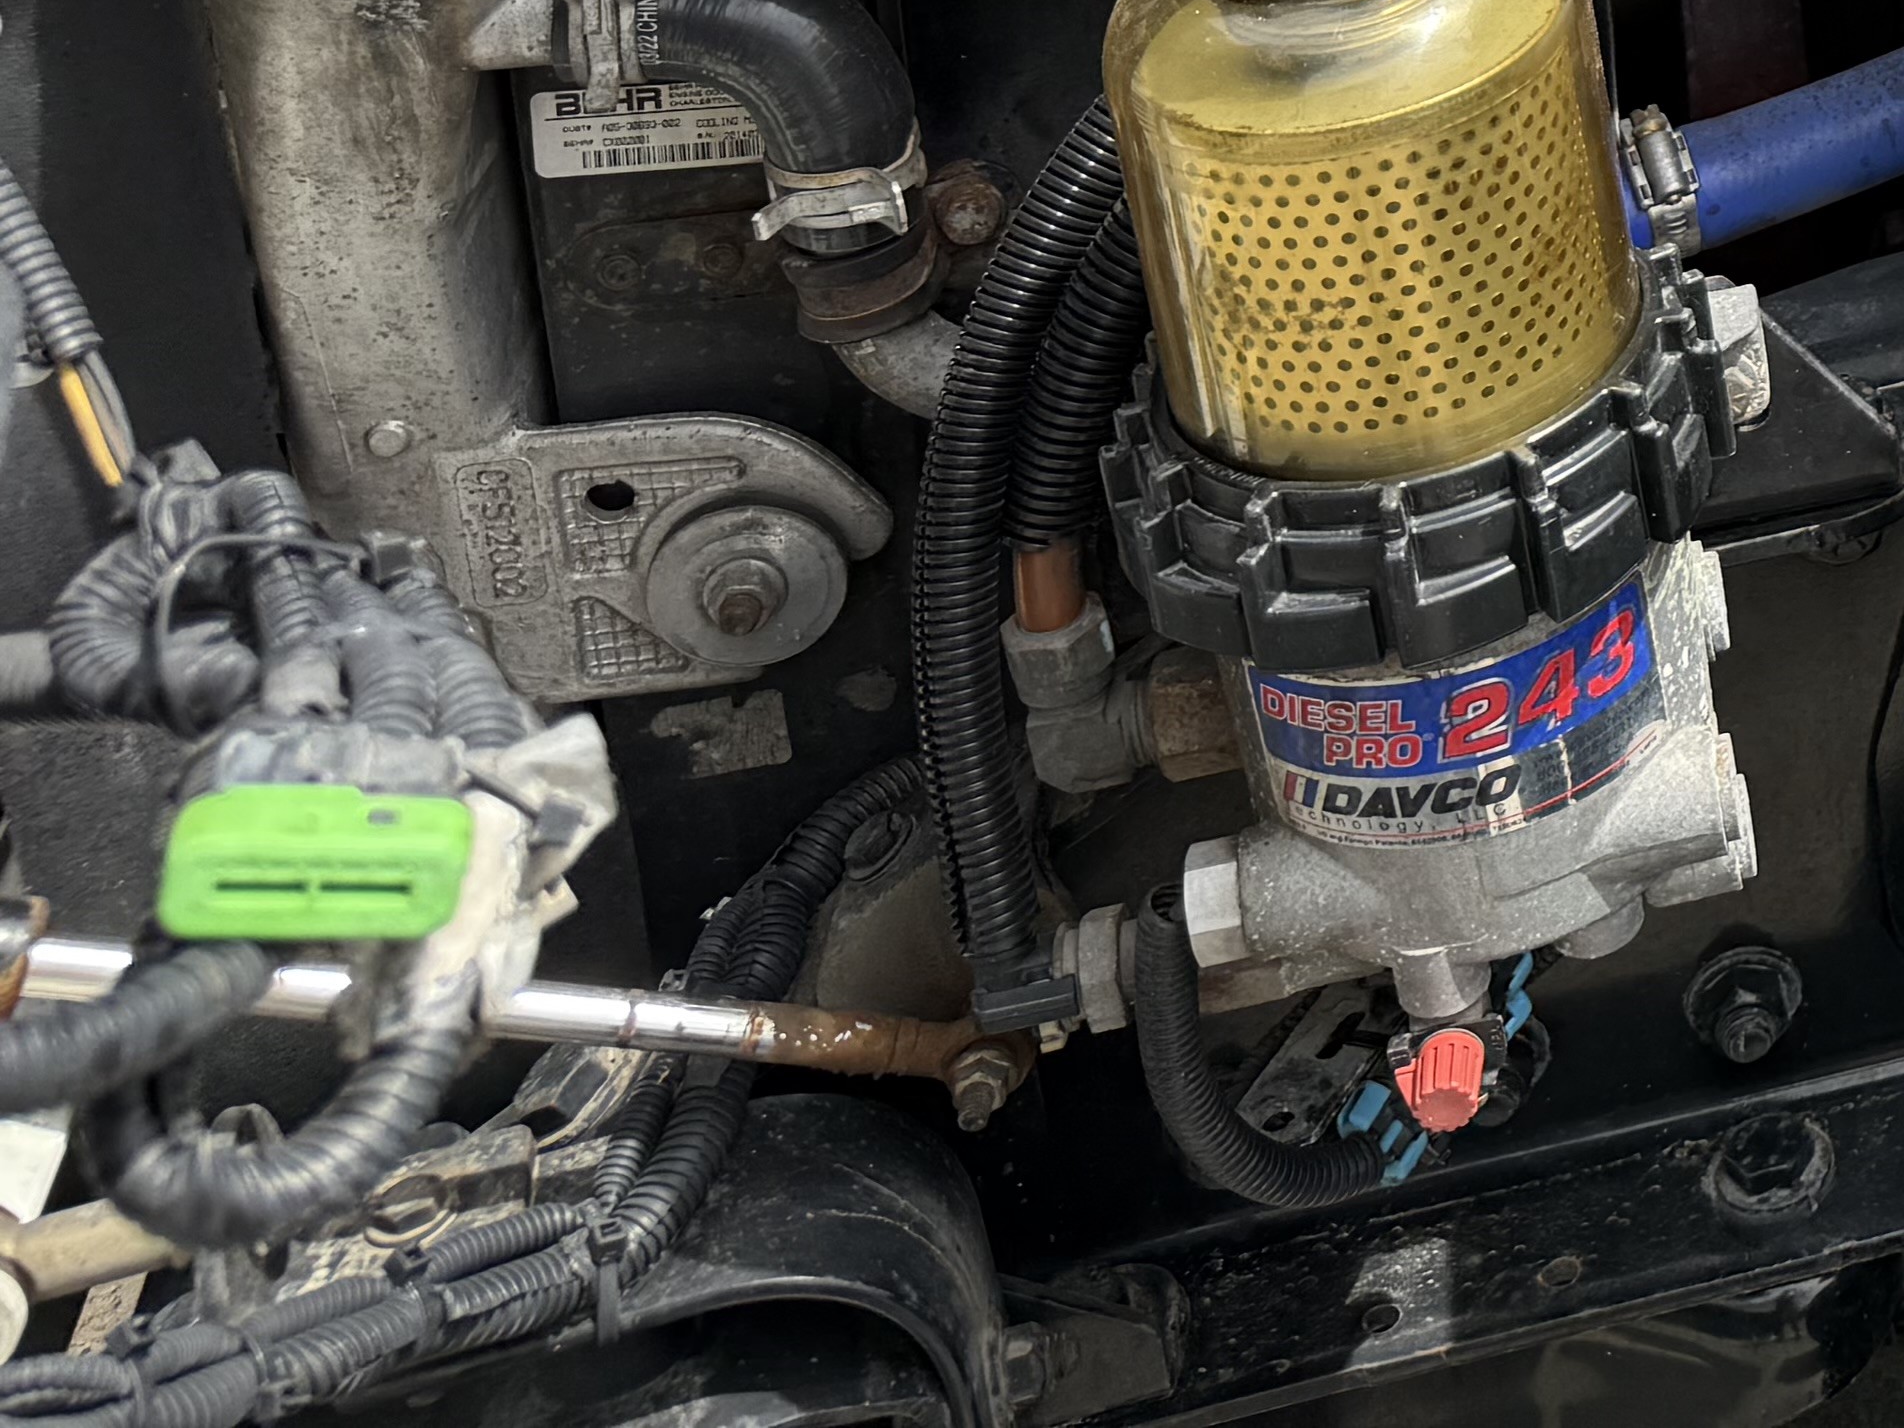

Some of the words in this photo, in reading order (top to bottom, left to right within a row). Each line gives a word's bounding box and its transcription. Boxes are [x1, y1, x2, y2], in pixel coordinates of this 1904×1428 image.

[555, 87, 663, 116] BHR
[1438, 609, 1635, 764] 243
[1260, 683, 1416, 734] DIESEL
[1323, 733, 1423, 769] PRO
[1321, 765, 1521, 821] DAVCO
[1293, 805, 1436, 834] echnology,
